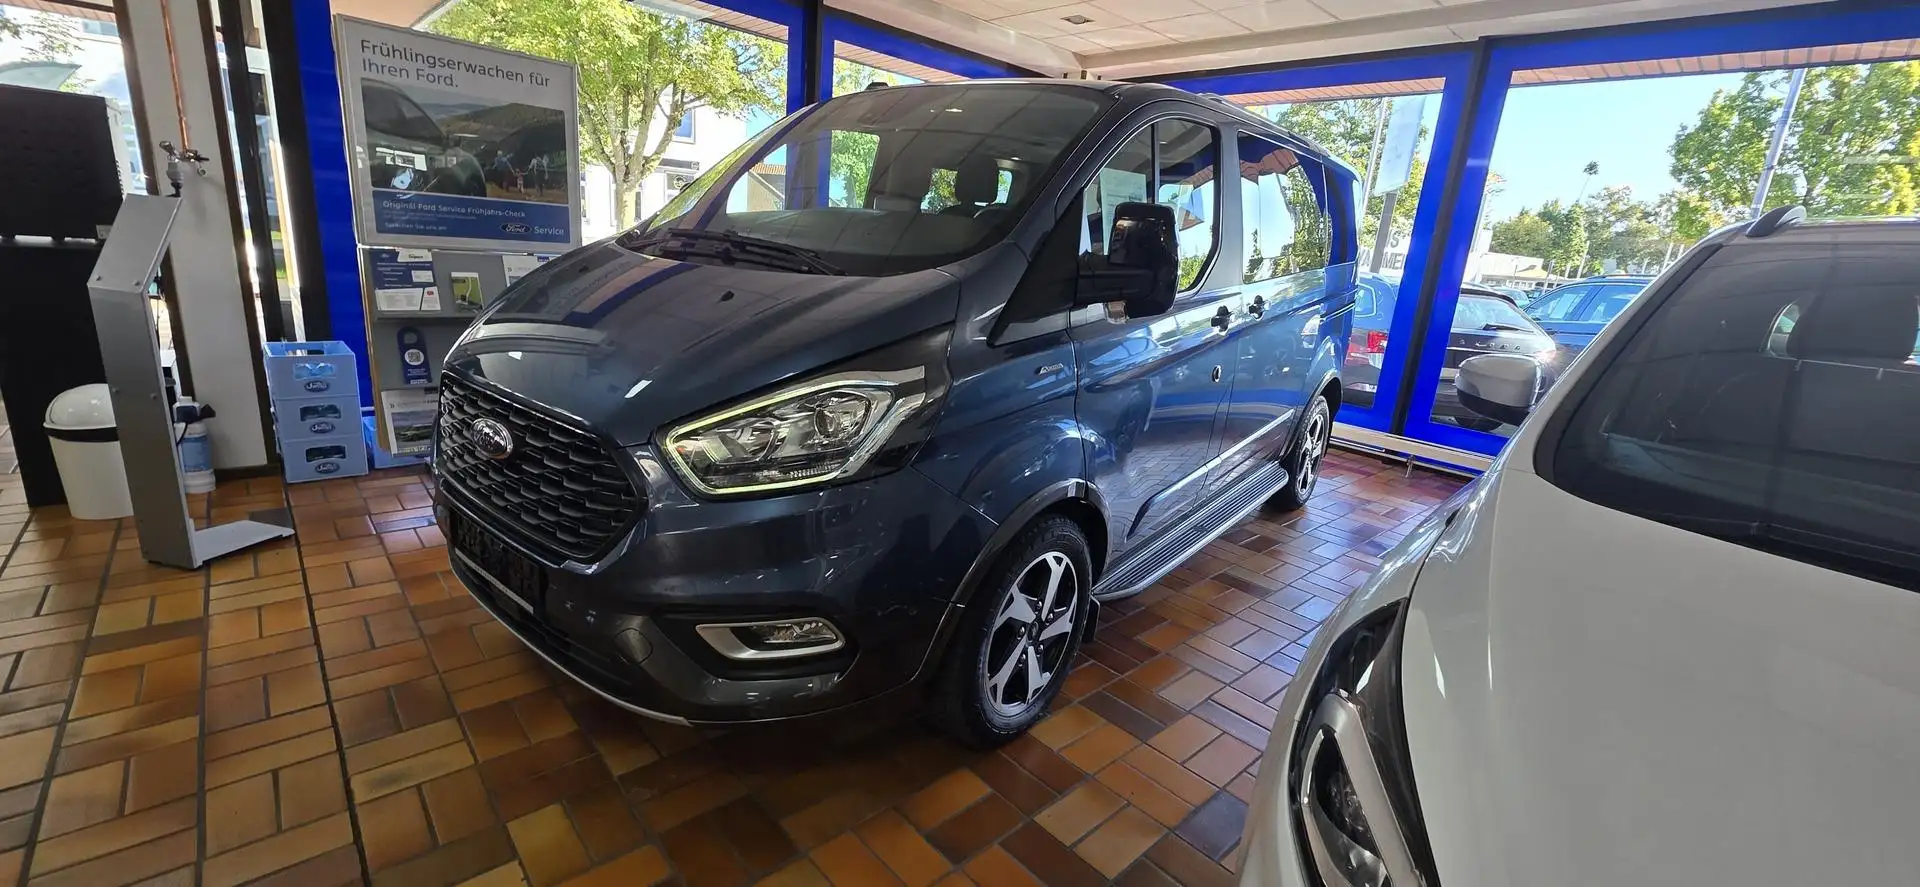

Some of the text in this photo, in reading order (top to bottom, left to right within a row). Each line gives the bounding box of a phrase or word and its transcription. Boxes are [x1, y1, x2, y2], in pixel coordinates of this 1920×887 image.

[360, 39, 550, 87] Frühlingserwachen für
[362, 58, 459, 88] Ihren Ford.
[382, 200, 416, 210] Original
[418, 203, 436, 212] Ford
[438, 205, 466, 214] Service
[467, 206, 526, 218] Frühjahrs-Check
[534, 226, 565, 236] Service
